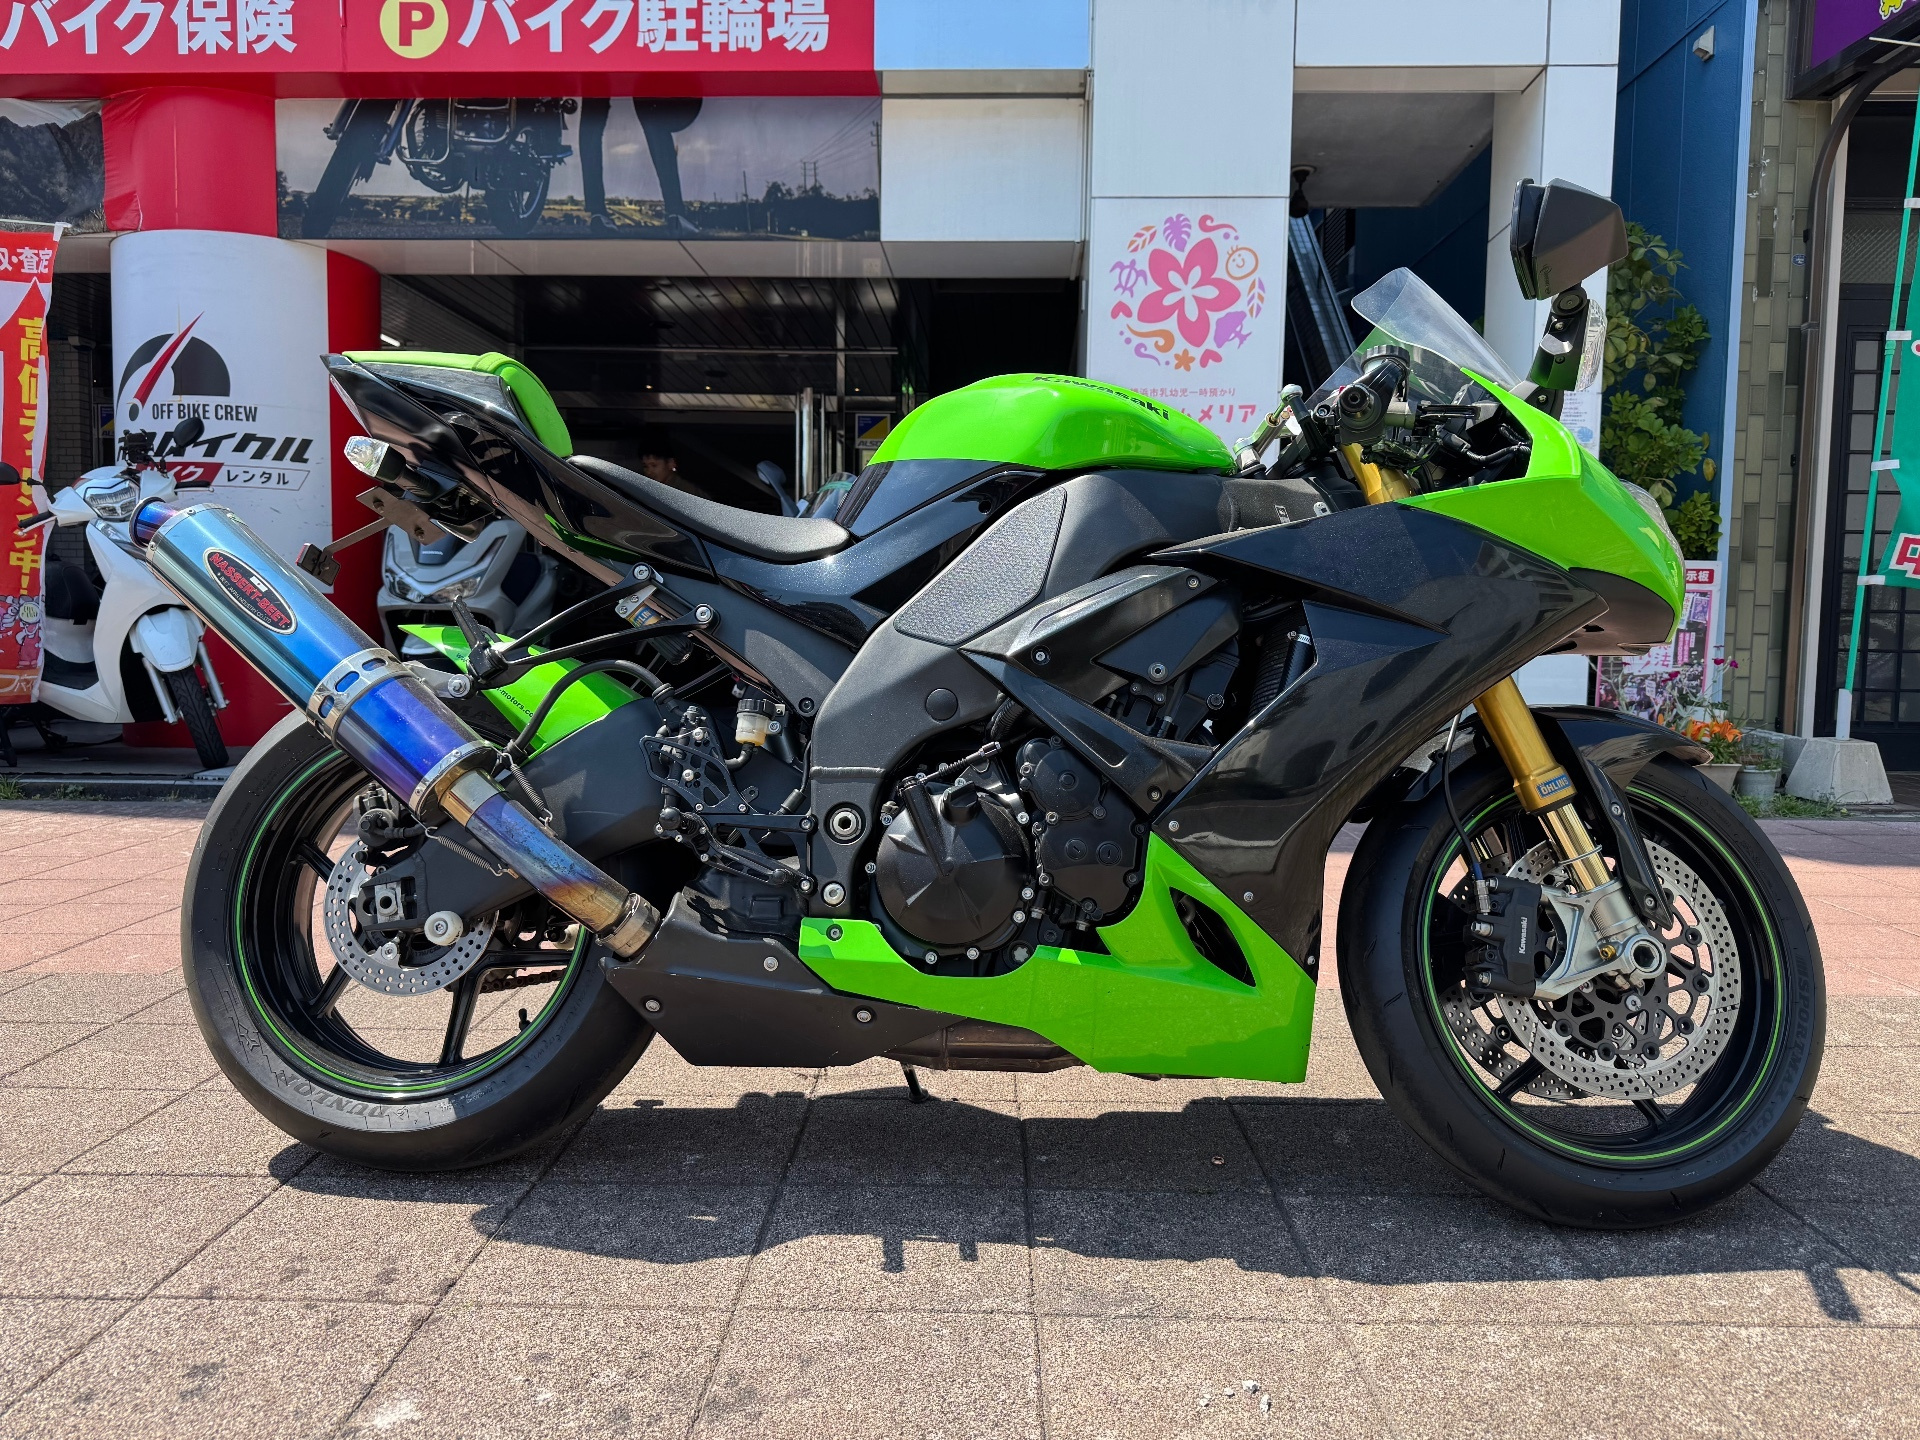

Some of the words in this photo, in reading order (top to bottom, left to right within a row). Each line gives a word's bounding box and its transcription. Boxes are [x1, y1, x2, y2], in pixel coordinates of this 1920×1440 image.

[0, 0, 298, 55] バイク保険
[457, 0, 830, 54] バイク駐輪場
[151, 403, 174, 420] OFF
[177, 403, 210, 421] BIKE
[214, 404, 258, 422] CREW
[1181, 404, 1257, 424] メリア
[226, 469, 289, 486] レンタル
[209, 552, 291, 627] NASSERT-BEET
[1539, 776, 1569, 795] ÖHLINS
[1518, 916, 1528, 955] Kawasaki
[1775, 977, 1811, 1100] SPORTMAX
[277, 1069, 392, 1119] DUNLOP
